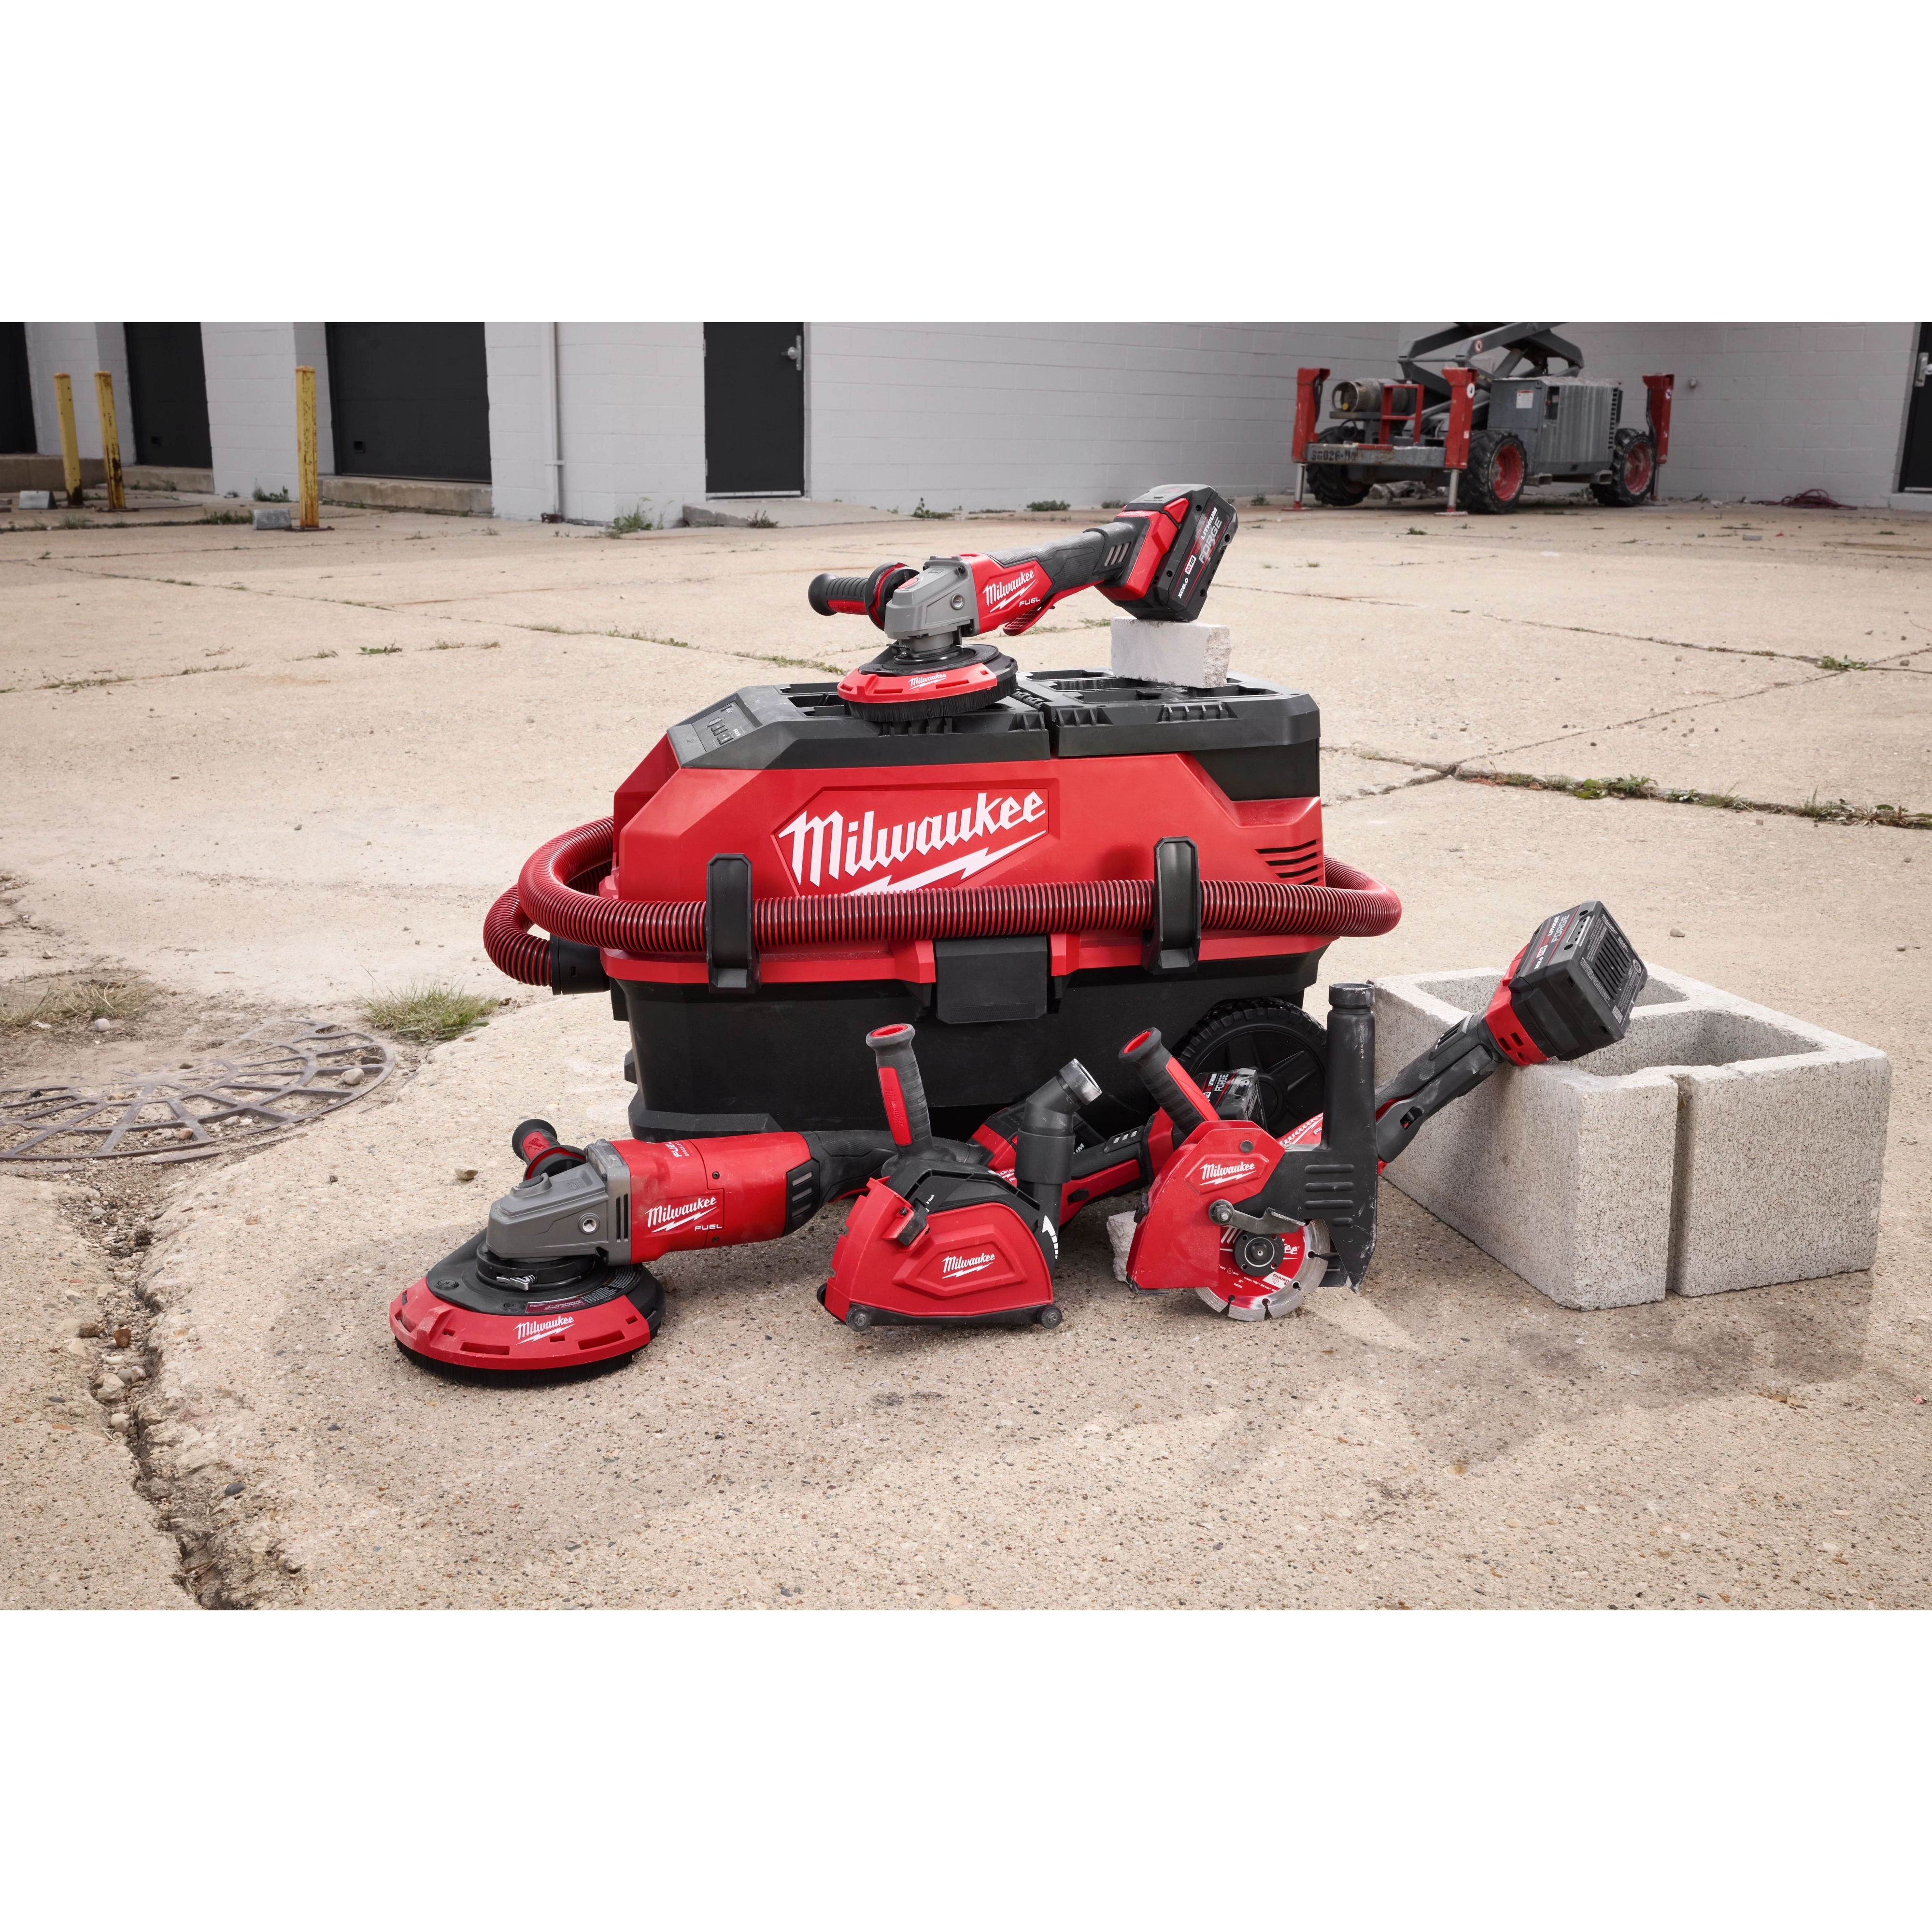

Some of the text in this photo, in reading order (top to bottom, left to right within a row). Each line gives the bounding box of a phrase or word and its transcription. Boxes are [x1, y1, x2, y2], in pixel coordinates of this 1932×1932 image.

[1198, 516, 1223, 564] FORGE
[1185, 555, 1196, 574] M18
[982, 570, 1035, 607] Milwaukee
[1019, 597, 1040, 607] FUEL
[908, 673, 947, 687] Milwaukee
[778, 791, 1046, 887] Milwaukee
[1550, 914, 1570, 943] FORGE
[1214, 1074, 1229, 1092] FORGE
[665, 1142, 682, 1157] FUEL
[1199, 1161, 1255, 1180] Milwaukee
[644, 1196, 717, 1228] Milwaukee
[941, 1252, 995, 1274] Milwaukee
[1272, 1273, 1290, 1283] DIAMO
[513, 1315, 575, 1340] Milwaukee
